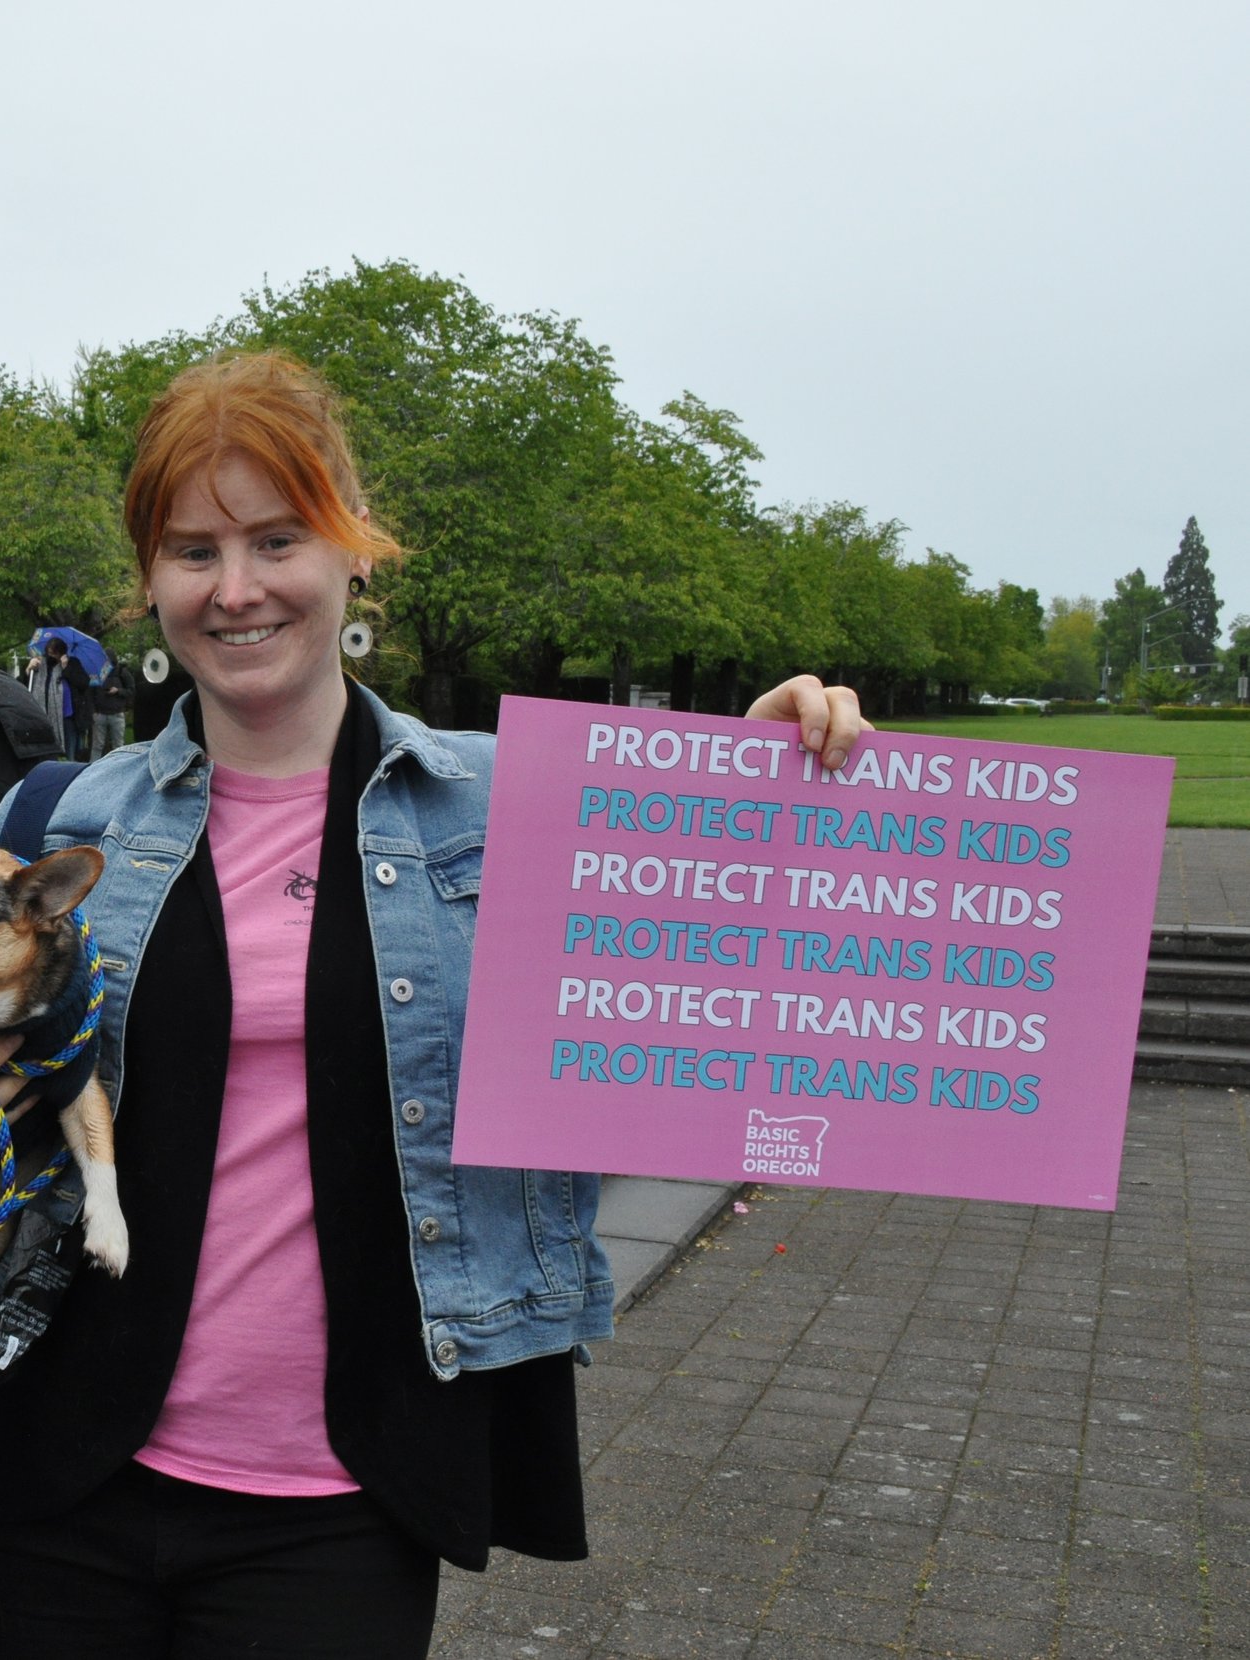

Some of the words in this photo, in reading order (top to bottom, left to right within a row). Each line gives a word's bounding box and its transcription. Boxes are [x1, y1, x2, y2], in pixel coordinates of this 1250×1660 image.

[585, 722, 790, 780] PROTECT
[965, 757, 1080, 806] KIDS
[578, 786, 783, 842] PROTECT
[790, 804, 948, 858] TRANS
[958, 819, 1073, 868] KIDS
[571, 849, 775, 905] PROTECT
[784, 867, 939, 919] TRANS
[950, 881, 1063, 930] KIDS
[564, 913, 769, 967] PROTECT
[777, 929, 933, 981] TRANS
[943, 944, 1056, 992] KIDS
[557, 976, 763, 1030] PROTECT
[771, 991, 925, 1043] TRANS
[936, 1005, 1048, 1054] KIDS
[550, 1039, 757, 1092] PROTECT
[765, 1054, 920, 1105] TRANS
[930, 1066, 1042, 1115] KIDS
[743, 1159, 819, 1176] OREGON
[745, 1143, 809, 1159] RIGHTS
[746, 1126, 799, 1142] BASIC
